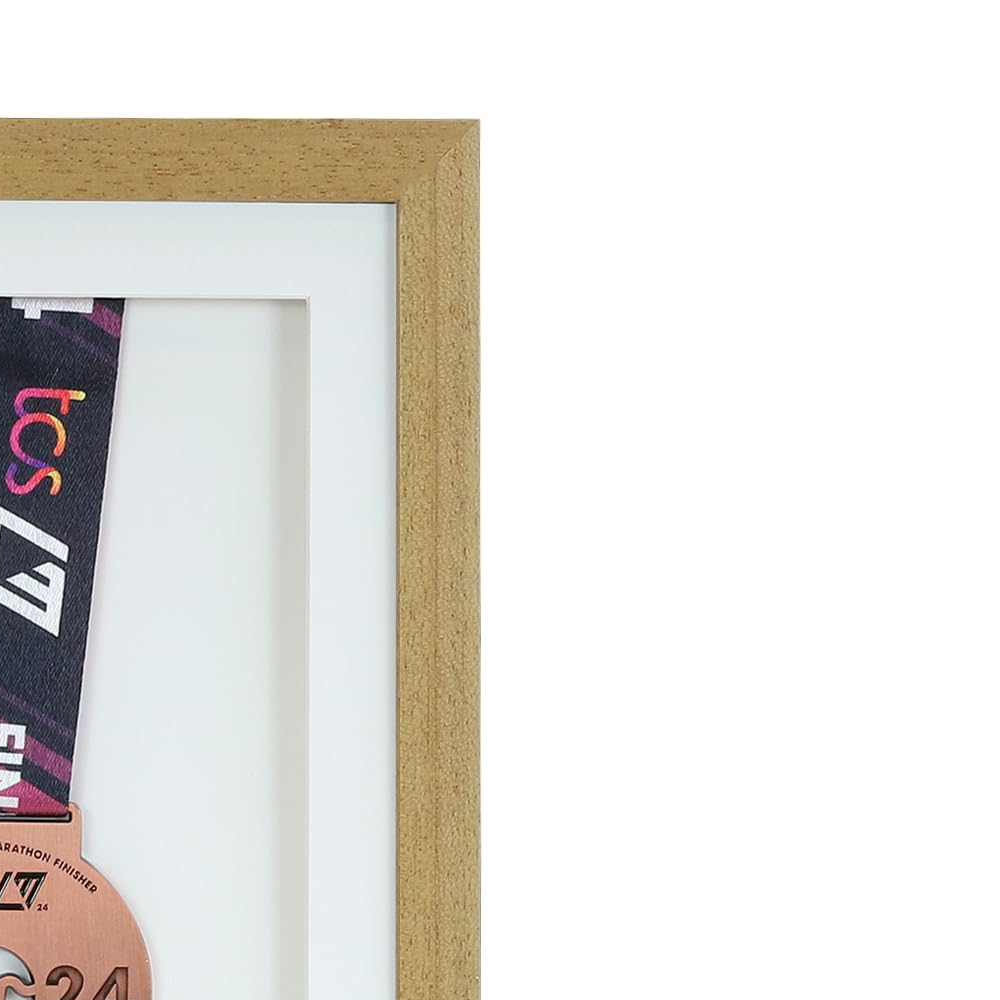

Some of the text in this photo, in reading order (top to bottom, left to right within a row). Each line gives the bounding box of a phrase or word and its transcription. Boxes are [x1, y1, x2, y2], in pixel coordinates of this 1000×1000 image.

[5, 387, 86, 495] tcs
[52, 858, 98, 894] FINISHER
[36, 903, 49, 912] 24
